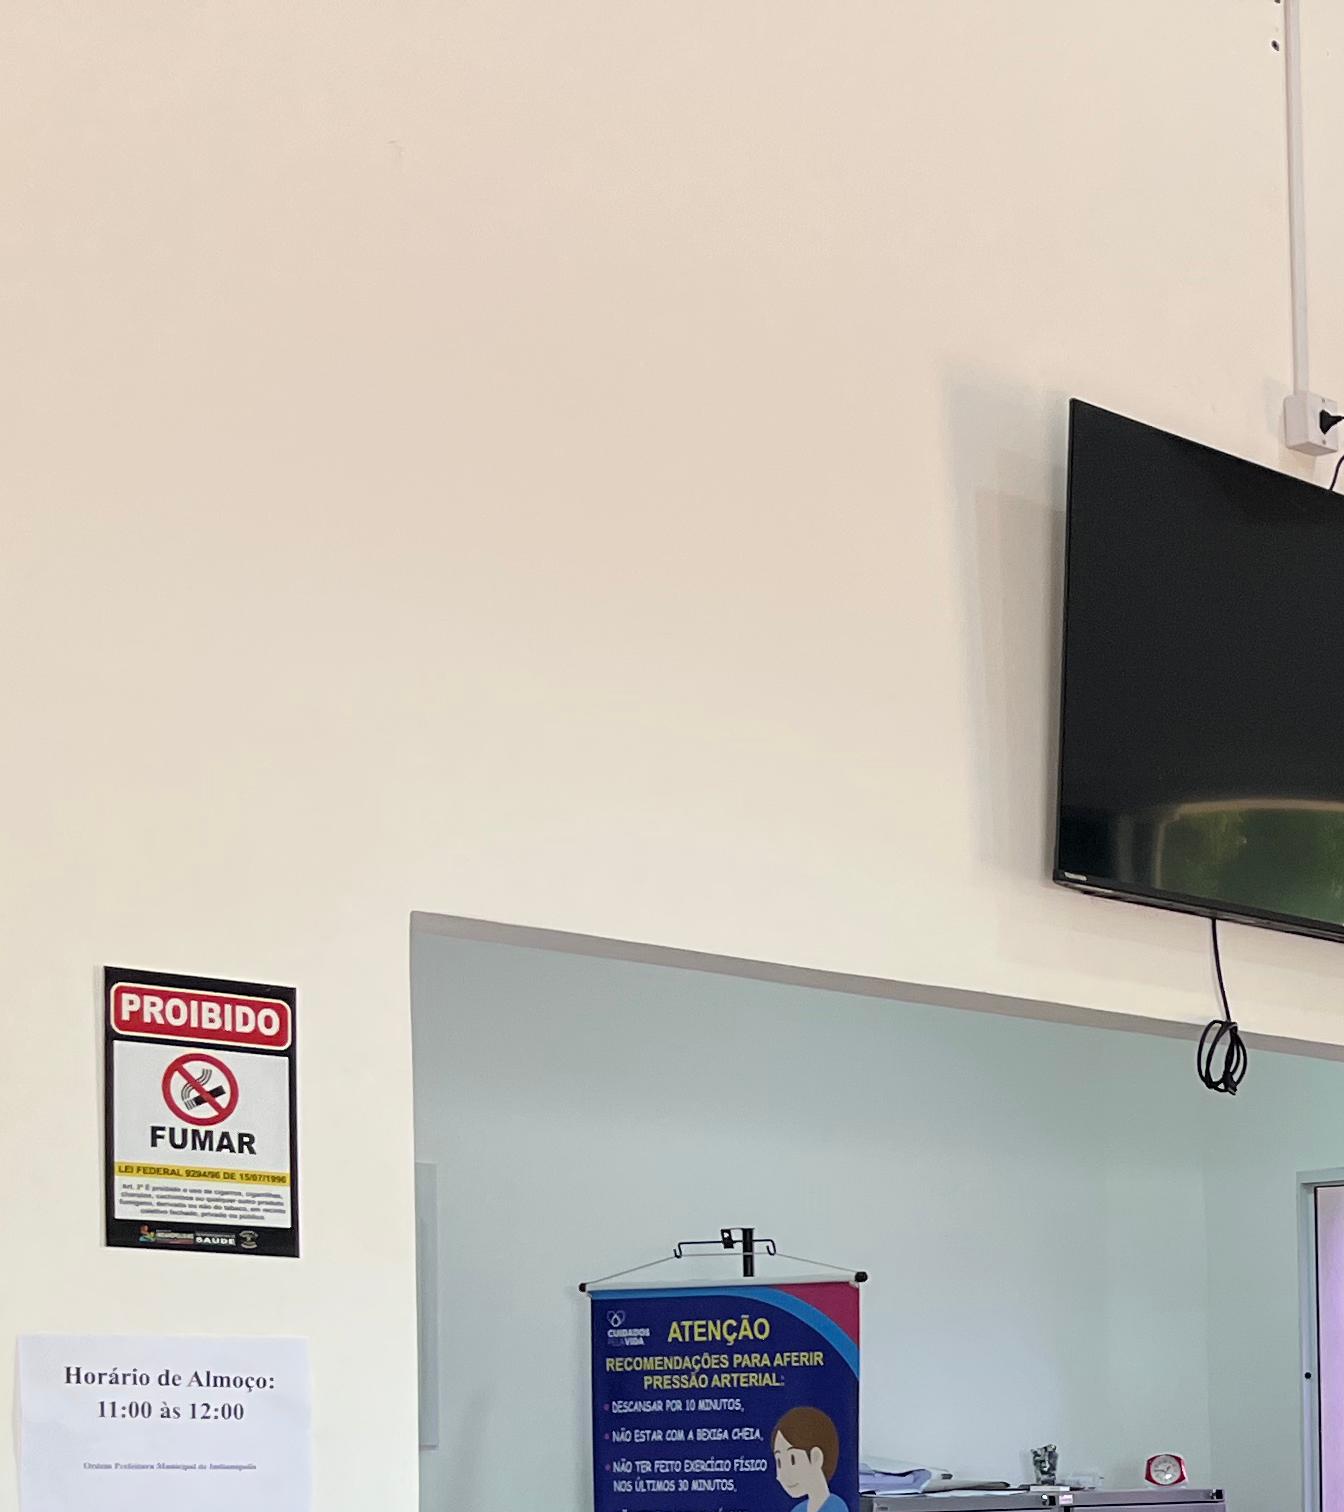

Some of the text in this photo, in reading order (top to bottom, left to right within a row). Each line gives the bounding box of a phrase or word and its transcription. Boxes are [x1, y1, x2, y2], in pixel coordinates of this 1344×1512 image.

[121, 992, 281, 1037] PROIBIDO
[150, 1125, 257, 1155] FUMAR
[118, 1165, 134, 1174] LEI
[136, 1165, 183, 1177] FEDERAL
[223, 1171, 237, 1180] DE
[667, 1314, 771, 1346] ATENÇÃO
[605, 1351, 824, 1374] RECOMENDAÇÕES PARA AFERIR
[64, 1365, 275, 1393] Horário de Almoço:
[643, 1371, 785, 1390] PRESSÃO ARTERIAL:
[98, 1400, 245, 1420] 11:00 às 12:00
[611, 1400, 664, 1414] DESCANSAR
[665, 1399, 683, 1412] POR
[685, 1399, 696, 1412] 10
[612, 1427, 632, 1443] NÃO
[634, 1429, 663, 1443] ESTAR
[665, 1429, 685, 1442] COM
[686, 1429, 694, 1441] A
[696, 1428, 729, 1441] BEXIGA
[612, 1456, 768, 1473] NÃO TER FEITO EXERCÍCIO FÍSICO
[613, 1479, 633, 1493] NOS
[634, 1476, 676, 1493] ÚLTIMOS
[678, 1479, 689, 1492] 30
